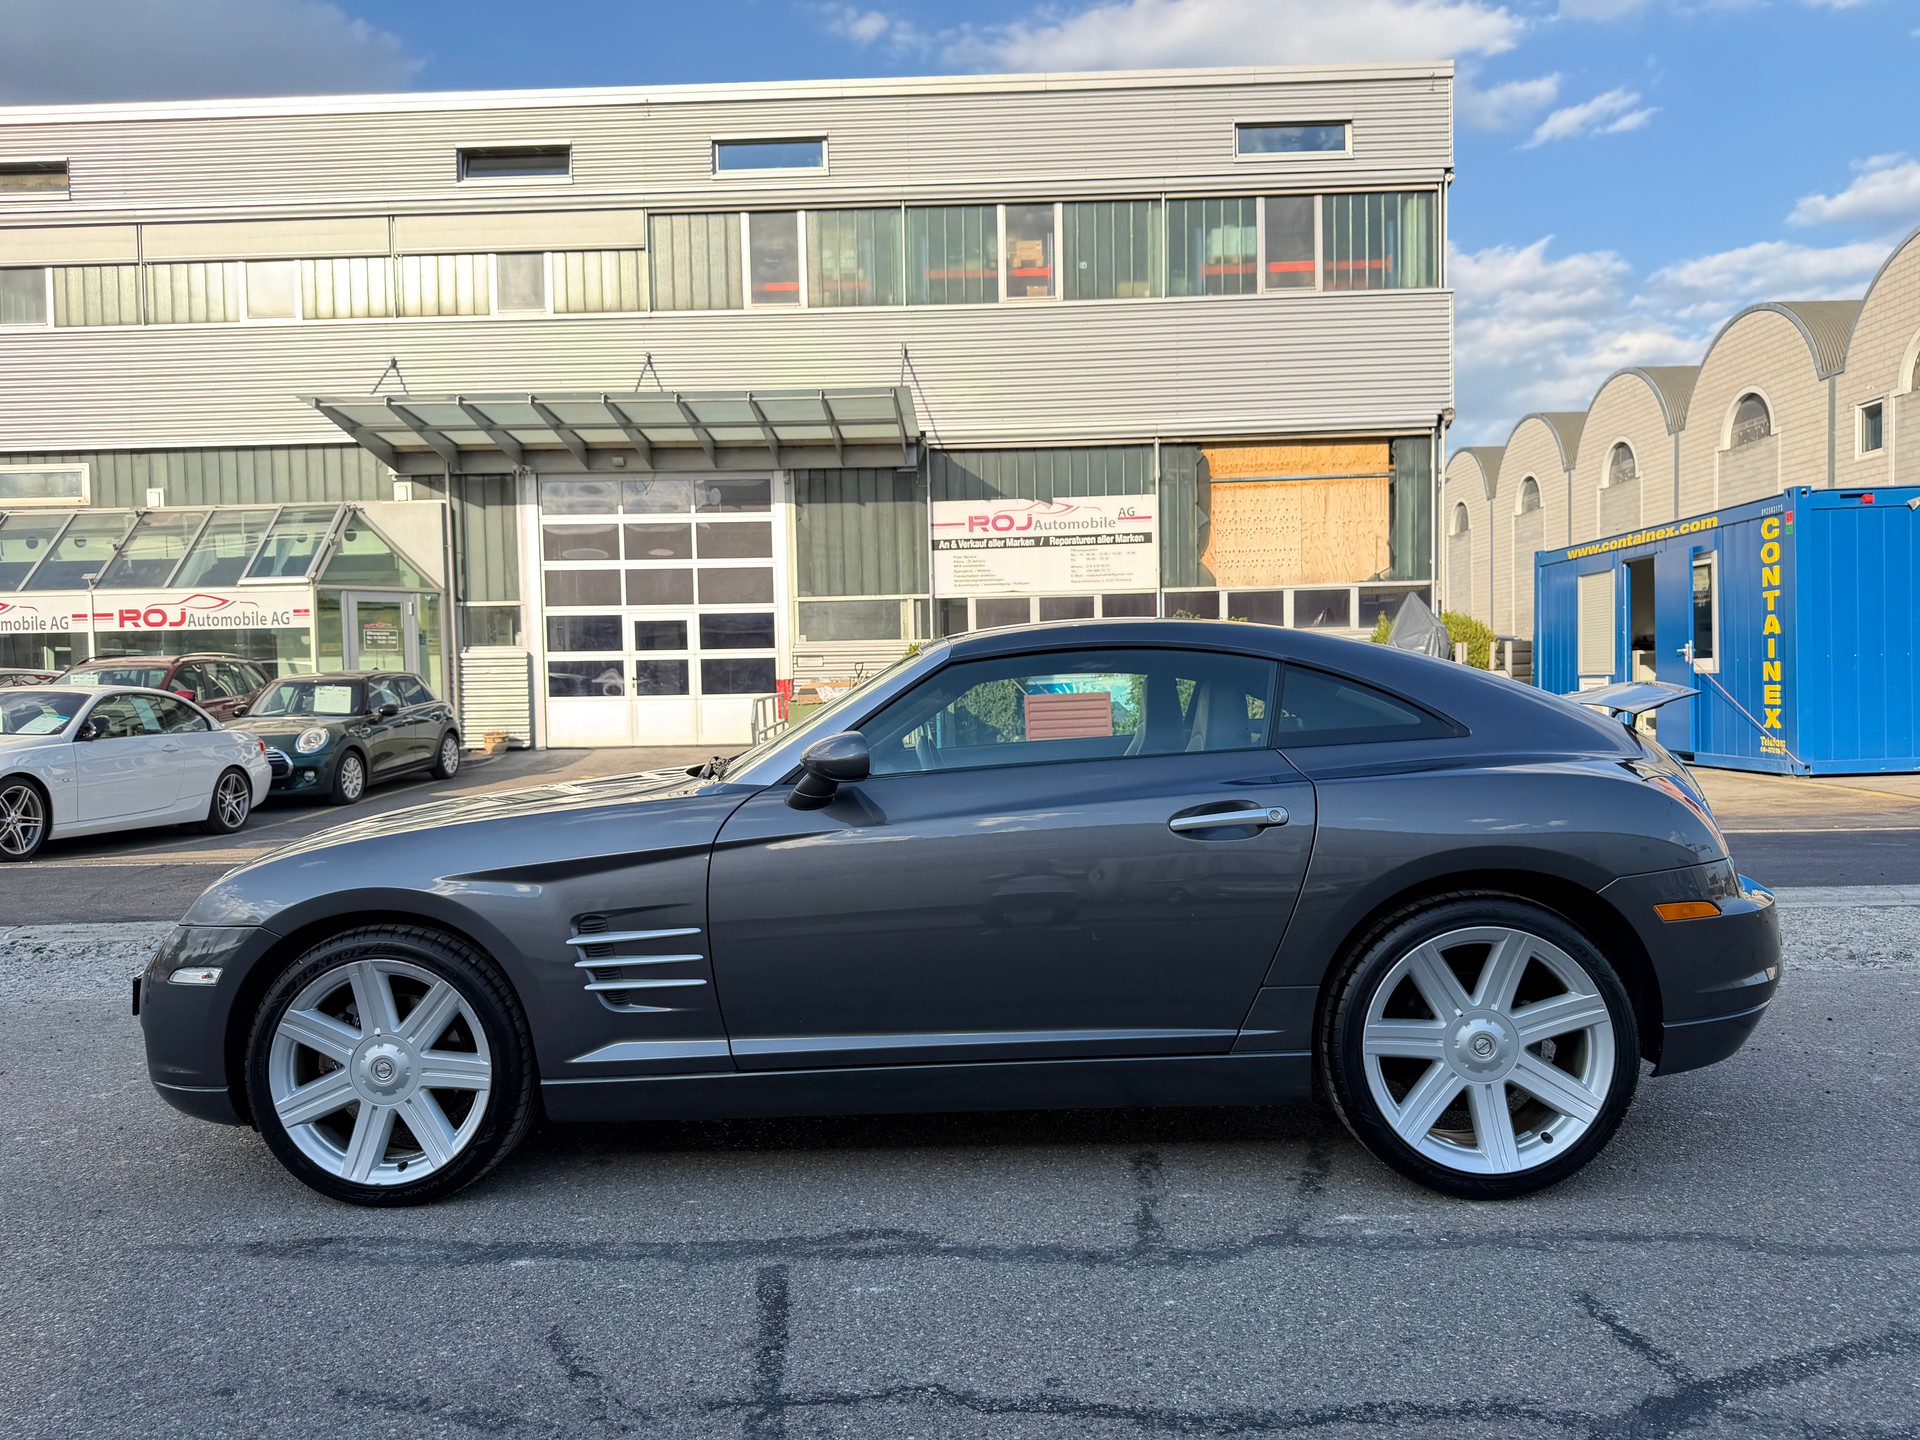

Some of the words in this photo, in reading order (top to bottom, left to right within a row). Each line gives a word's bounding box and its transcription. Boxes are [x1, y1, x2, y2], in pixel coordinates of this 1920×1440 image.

[968, 514, 1033, 533] ROJ
[1033, 517, 1116, 531] Automobile
[1118, 507, 1136, 517] AG
[938, 540, 950, 550] An
[951, 540, 958, 549] &
[958, 538, 988, 549] Verkauf
[988, 538, 1005, 548] aller
[1005, 537, 1035, 547] Marken
[1049, 535, 1097, 547] Reparaturen
[1097, 534, 1115, 544] aller
[1115, 533, 1145, 543] Marken
[1567, 516, 1719, 560] www.containex.com
[0, 615, 47, 631] mobile
[50, 616, 69, 630] AG
[118, 608, 187, 628] ROJ
[187, 611, 268, 627] Automobile
[271, 611, 290, 625] AG
[1760, 517, 1783, 729] CONTAINEX
